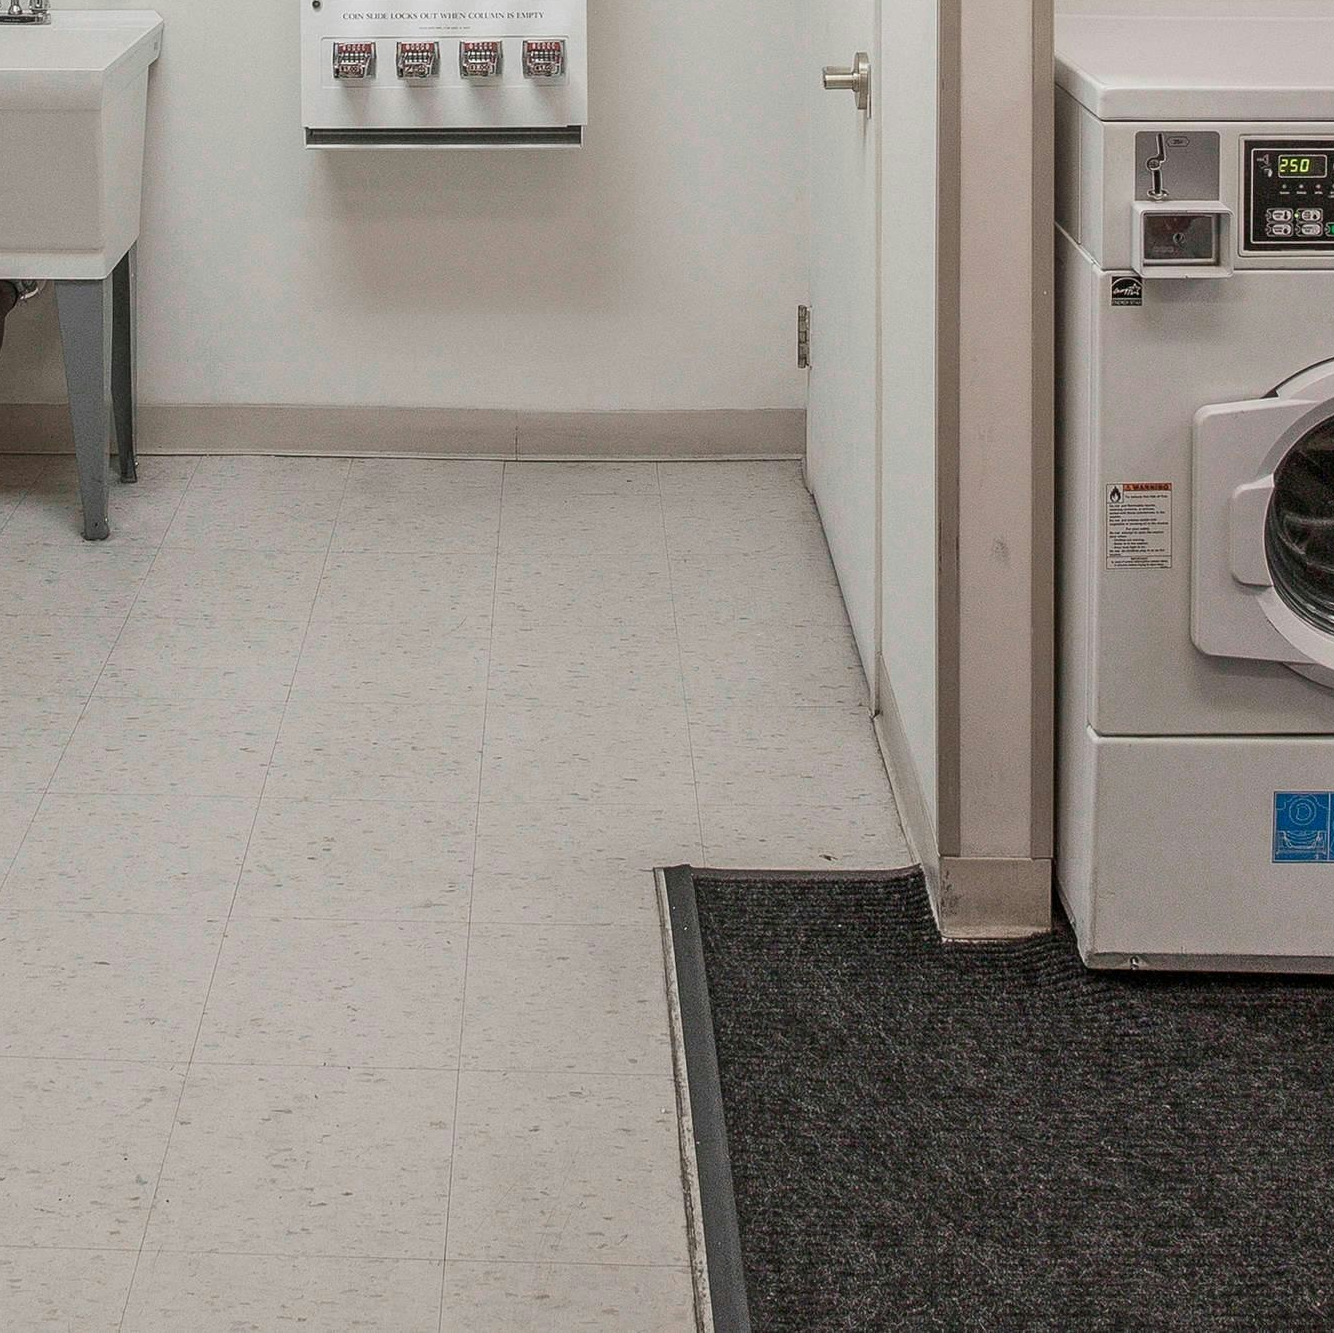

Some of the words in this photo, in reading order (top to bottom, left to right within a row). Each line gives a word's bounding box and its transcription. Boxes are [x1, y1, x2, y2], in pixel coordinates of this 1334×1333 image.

[390, 12, 418, 20] LOCKS
[516, 11, 545, 19] EMPTY
[1279, 158, 1310, 173] 250
